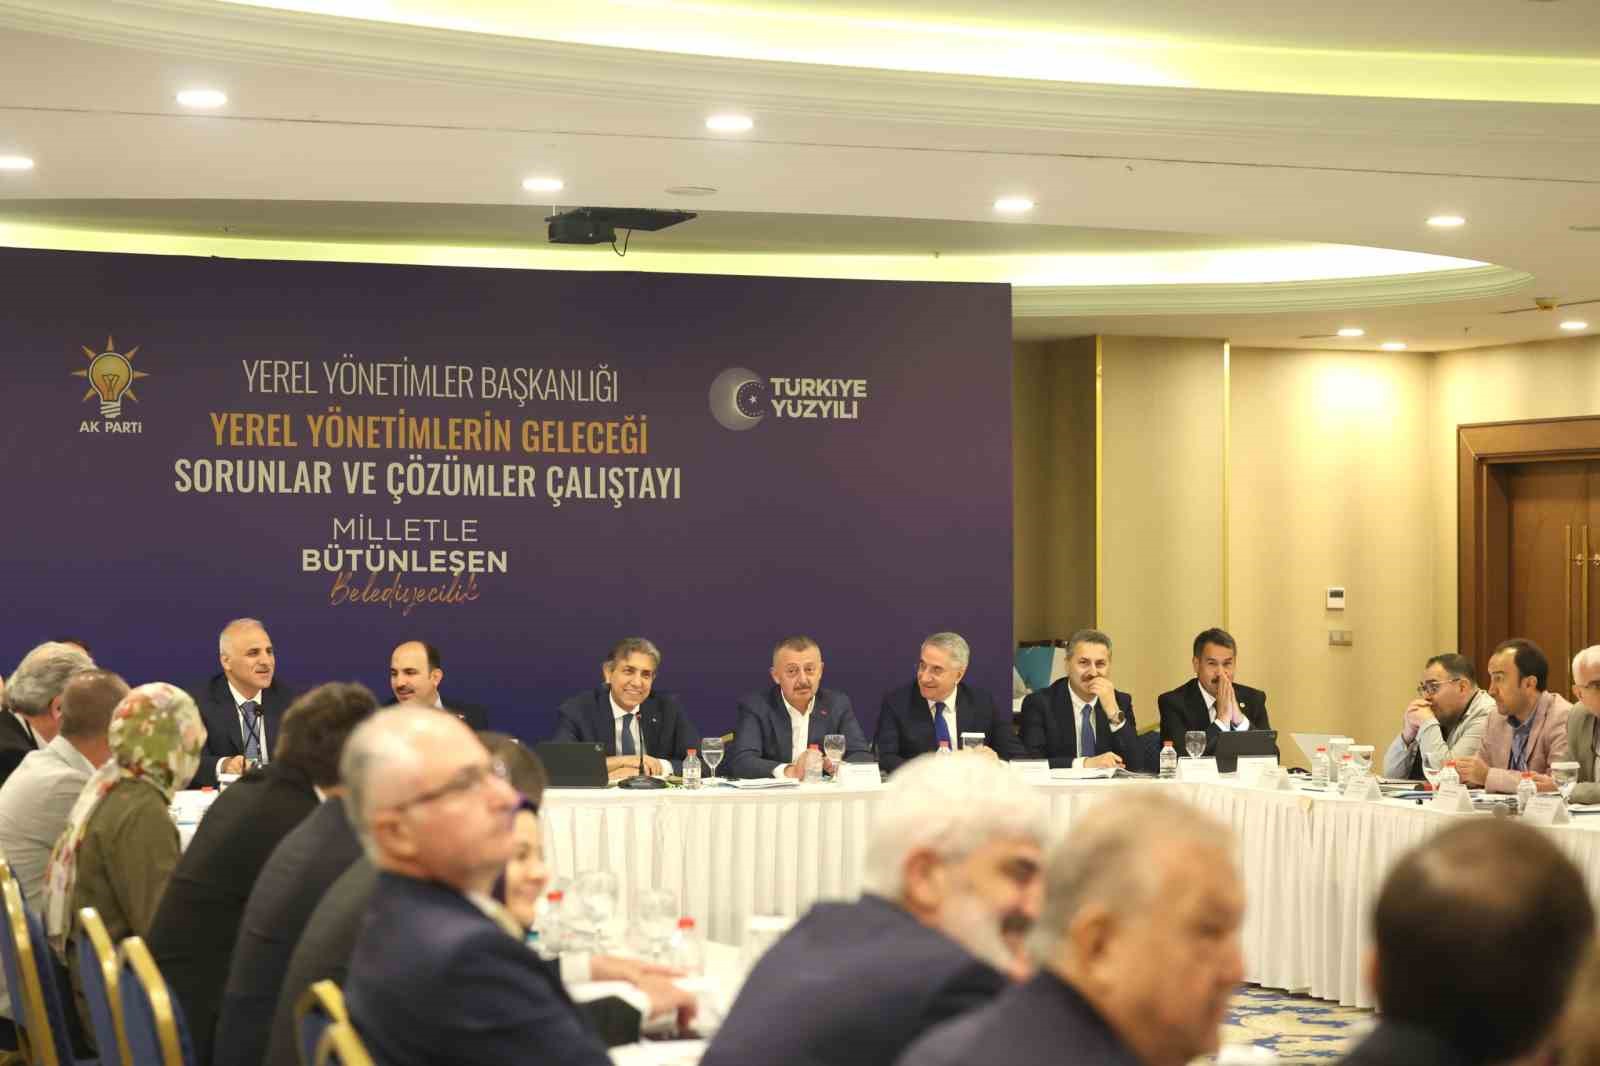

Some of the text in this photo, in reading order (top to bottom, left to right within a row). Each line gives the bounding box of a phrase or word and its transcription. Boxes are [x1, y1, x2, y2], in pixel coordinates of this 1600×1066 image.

[242, 353, 619, 407] YEREL YÖNETİMLER BAŞKANLIĞI
[80, 421, 100, 433] AK
[210, 406, 648, 454] YEREL YÖNETİMLERİN GELECEĞİ
[174, 454, 681, 508] SORUNLAR VE ÇÖZÜMLER ÇALIŞTAYI
[333, 513, 478, 542] MİLLETLE
[302, 544, 507, 576] BÜTÜNLEŞEN
